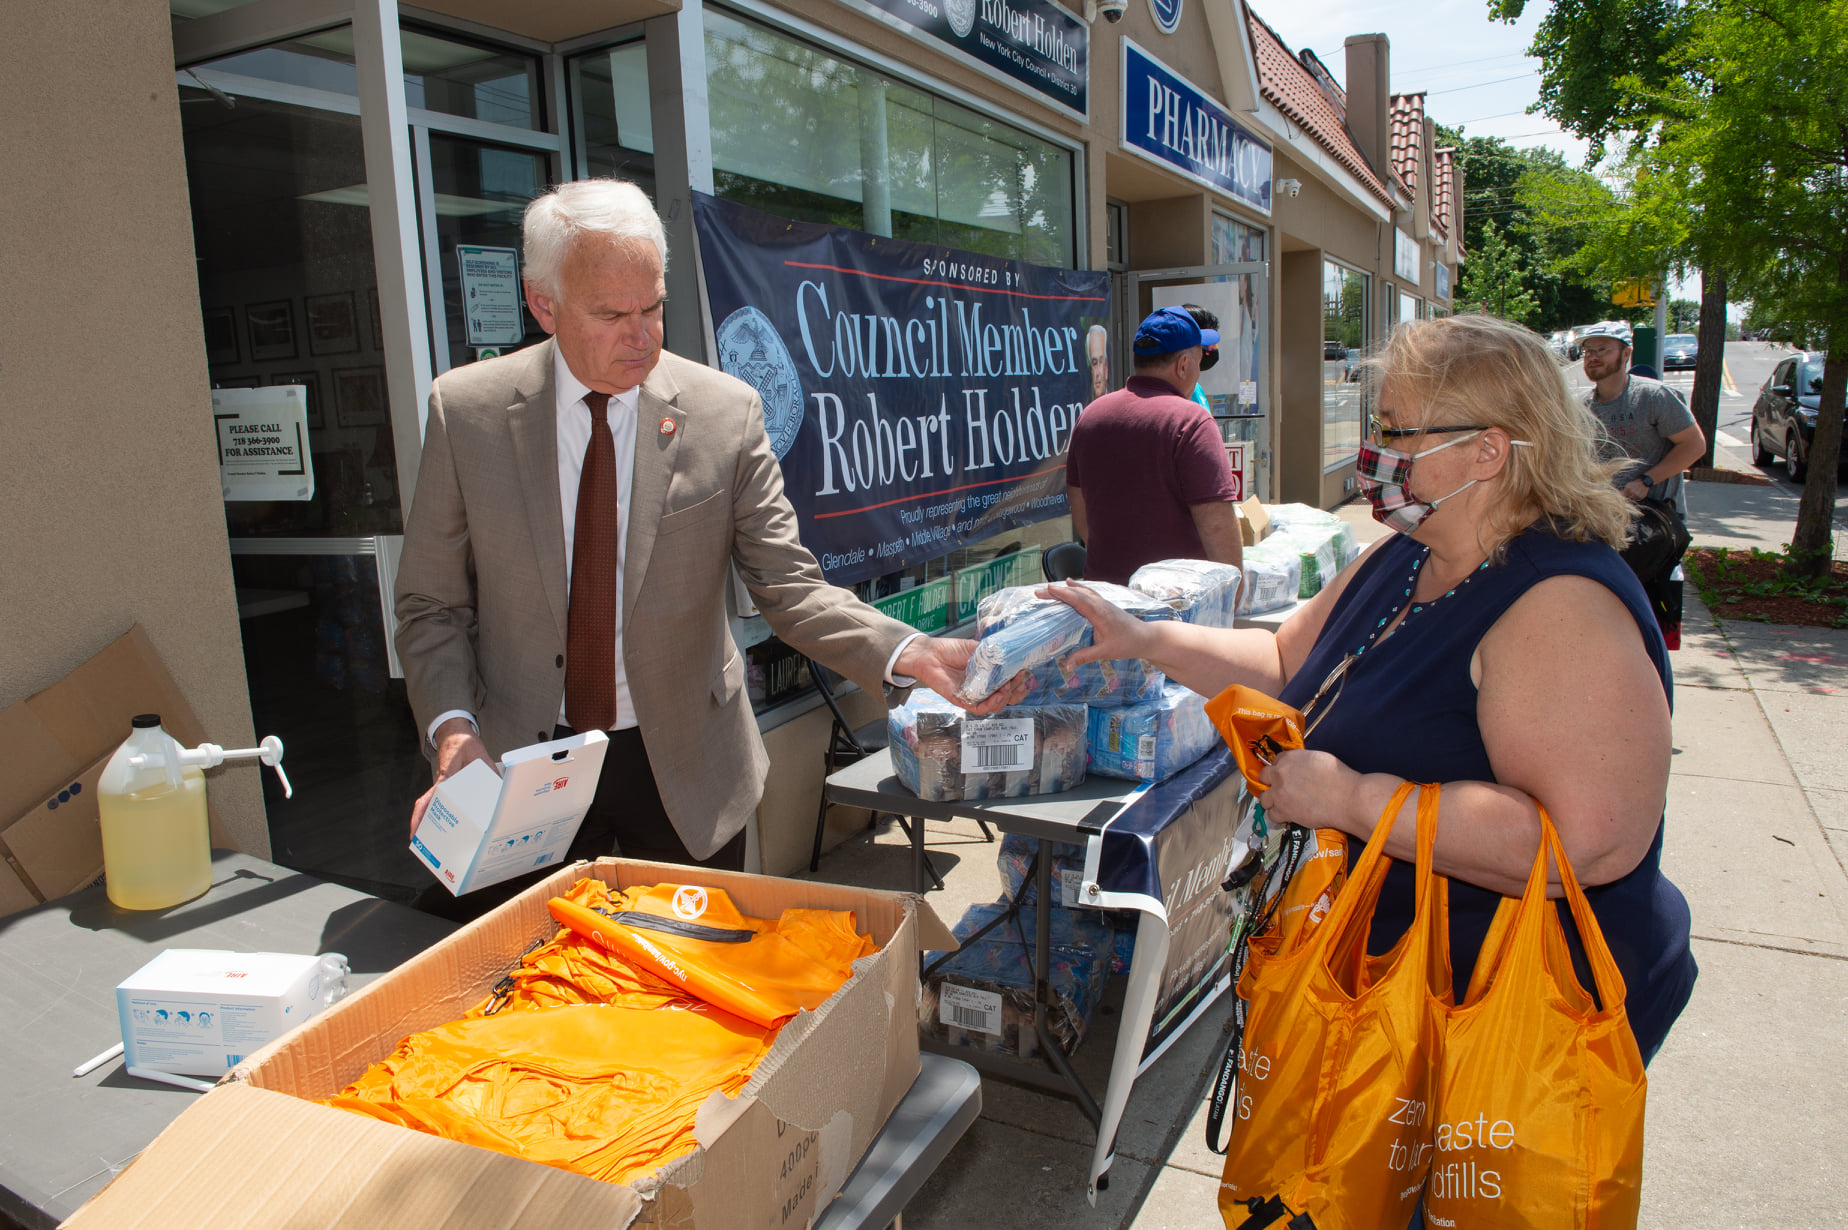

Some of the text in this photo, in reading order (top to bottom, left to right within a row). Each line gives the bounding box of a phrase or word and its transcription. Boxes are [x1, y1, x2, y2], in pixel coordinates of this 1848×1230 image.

[980, 0, 1078, 75] Robert Holden
[980, 32, 1078, 96] New York City Council District 30
[1146, 74, 1264, 195] PHARMACY
[923, 258, 1021, 288] SPONSORED BY
[796, 280, 1080, 380] Council Member
[228, 423, 282, 434] PLEASE CALL
[233, 437, 246, 446] 718
[810, 387, 1083, 497] Robert Holden
[225, 446, 294, 457] FOR ASSISTANCE
[900, 506, 925, 525] Proudly
[925, 498, 966, 519] representing
[967, 495, 981, 508] the
[982, 491, 1002, 509] great
[822, 547, 865, 571] Glendale
[876, 537, 905, 559] Maspeth
[911, 528, 932, 548] Middle
[931, 524, 952, 541] Village
[957, 516, 973, 533] and
[1031, 493, 1065, 510] Woodhaven
[877, 585, 948, 622] OBERT F HOLDEN
[958, 555, 1022, 615] CALDWELL
[917, 613, 936, 631] DRIVE
[1237, 707, 1251, 716] This
[1252, 710, 1266, 719] bag
[1014, 733, 1029, 742] CAT
[1284, 840, 1301, 881] FANDANGO
[983, 1003, 997, 1012] CAT
[1217, 1058, 1234, 1104] FANDANGO
[1434, 1111, 1515, 1152] aste
[1388, 1138, 1408, 1171] to
[1432, 1161, 1501, 1199] dfills
[781, 1174, 813, 1225] Made
